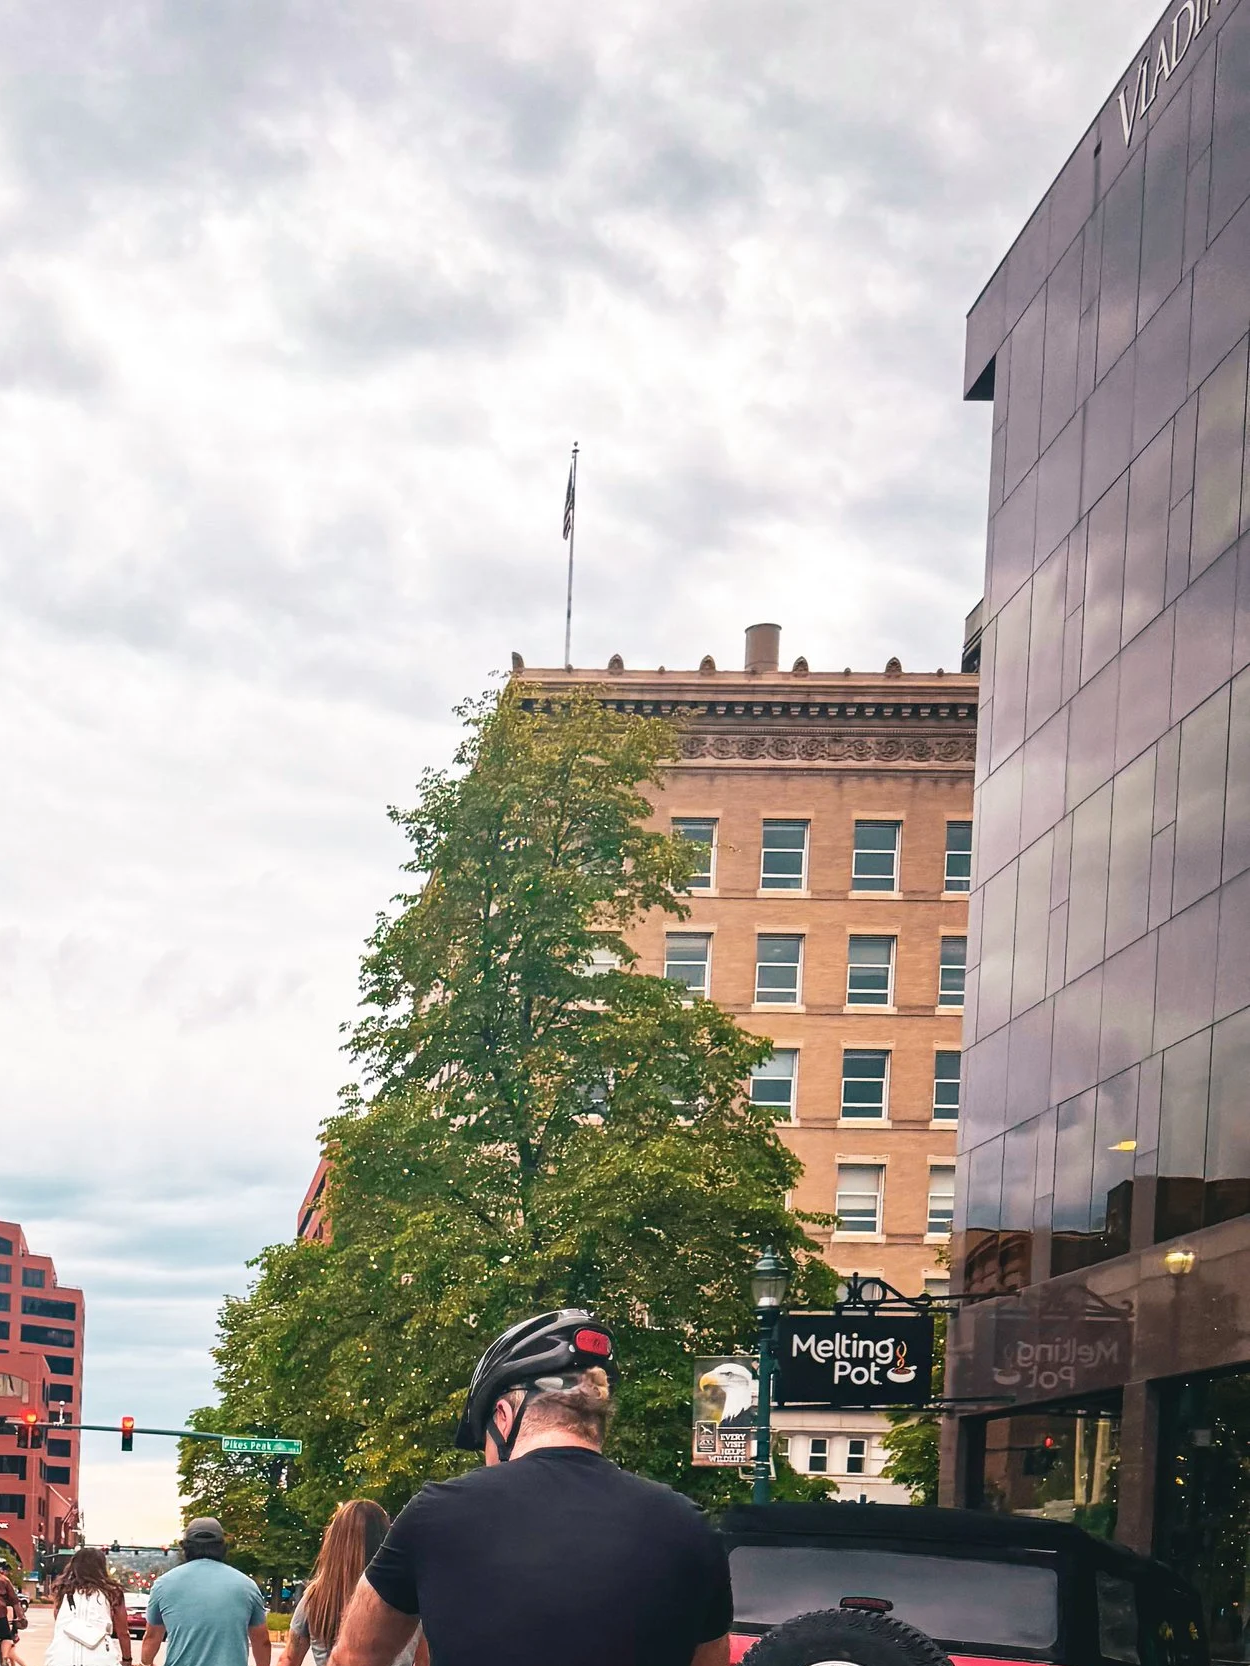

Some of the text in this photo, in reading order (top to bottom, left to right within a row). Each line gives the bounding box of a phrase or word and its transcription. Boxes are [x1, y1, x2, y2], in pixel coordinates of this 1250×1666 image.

[1118, 0, 1220, 149] VLADI
[792, 1332, 895, 1365] Melting
[833, 1361, 881, 1385] Pot
[720, 1433, 746, 1441] EVERY
[224, 1440, 272, 1451] Pikes Peak
[721, 1448, 746, 1456] HELPS
[707, 1455, 746, 1463] WILDLIFE
